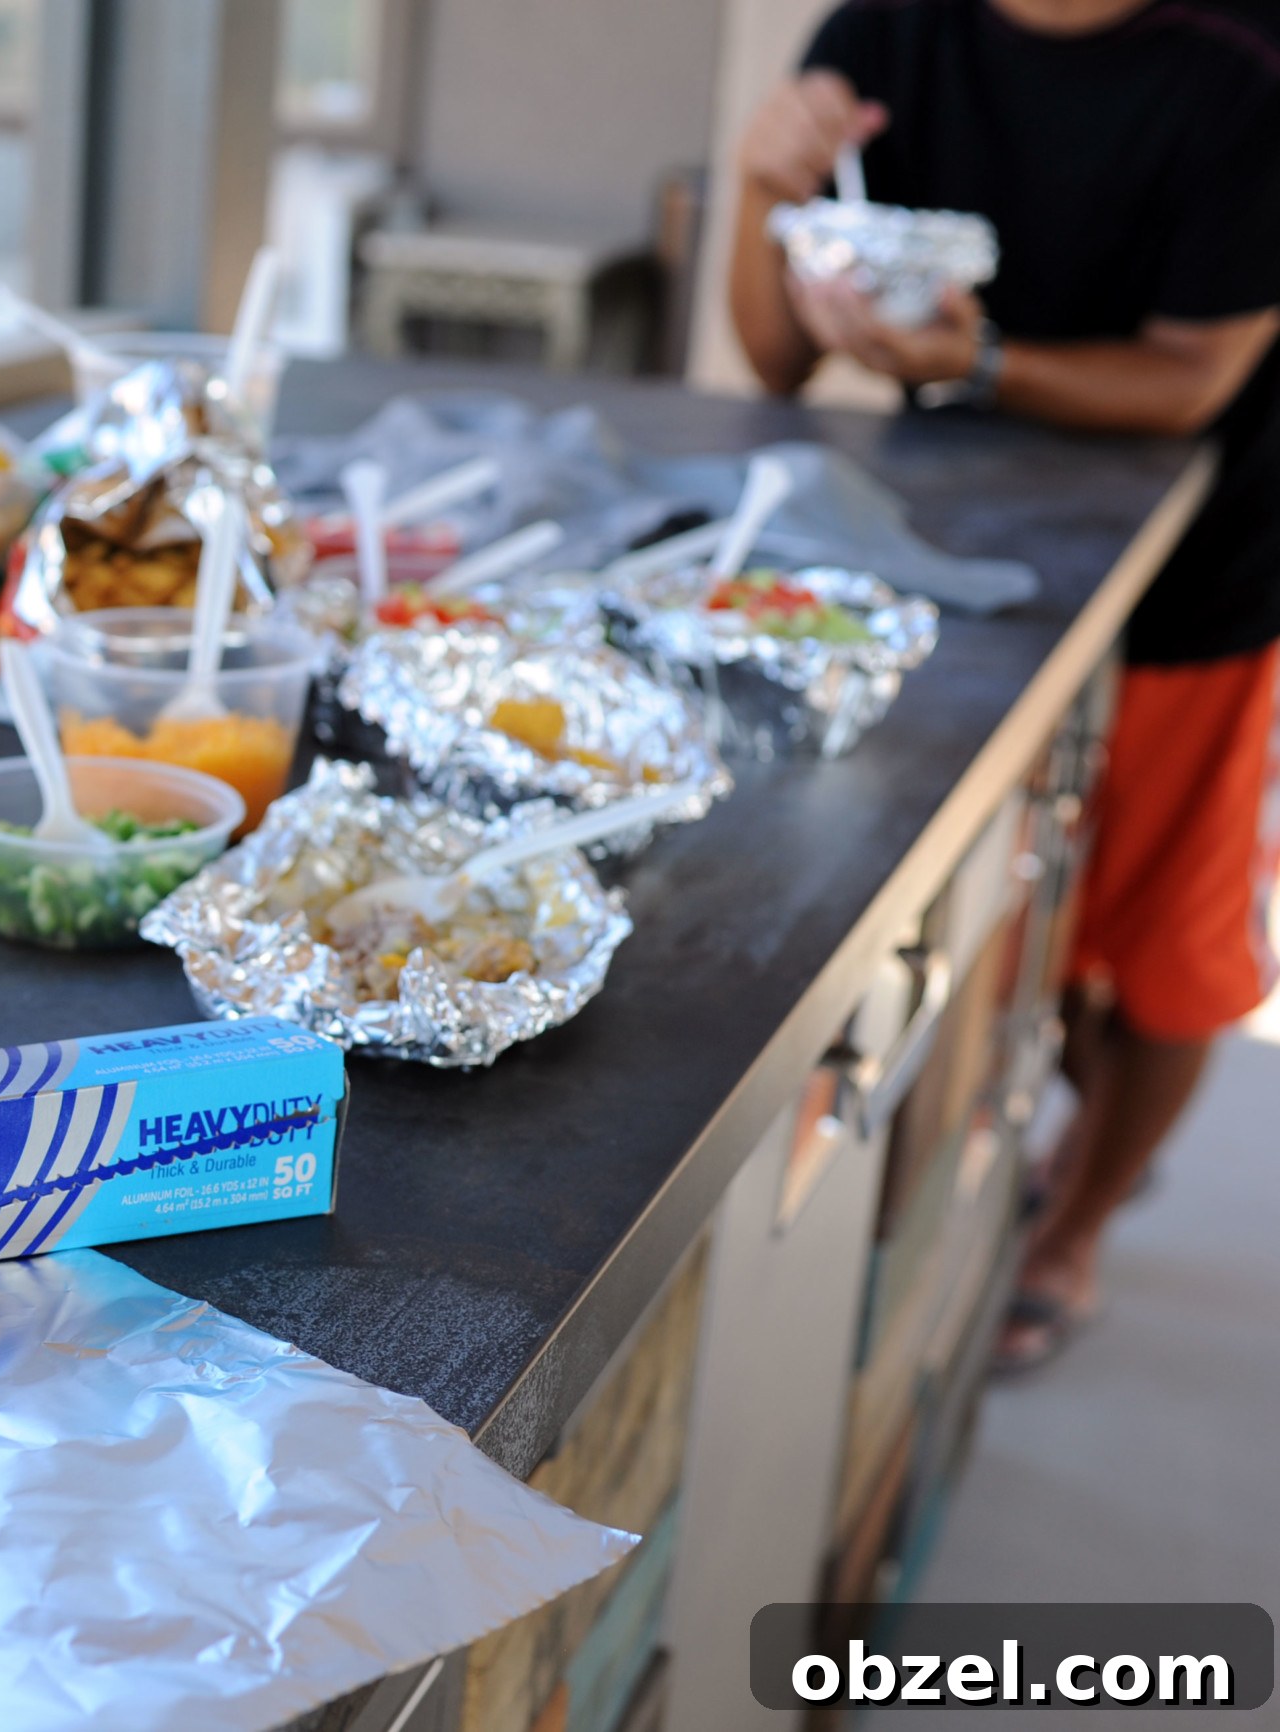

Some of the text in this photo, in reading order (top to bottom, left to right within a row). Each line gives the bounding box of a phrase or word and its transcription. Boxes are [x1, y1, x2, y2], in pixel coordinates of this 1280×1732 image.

[267, 1034, 317, 1050] 50
[151, 1152, 257, 1181] Thick & Durable
[273, 1152, 317, 1187] 50
[121, 1189, 173, 1206] ALUMINUM
[173, 1186, 195, 1200] FOIL
[221, 1179, 240, 1192] YDS
[272, 1182, 315, 1200] SQ FT
[154, 1201, 176, 1214] 4.64
